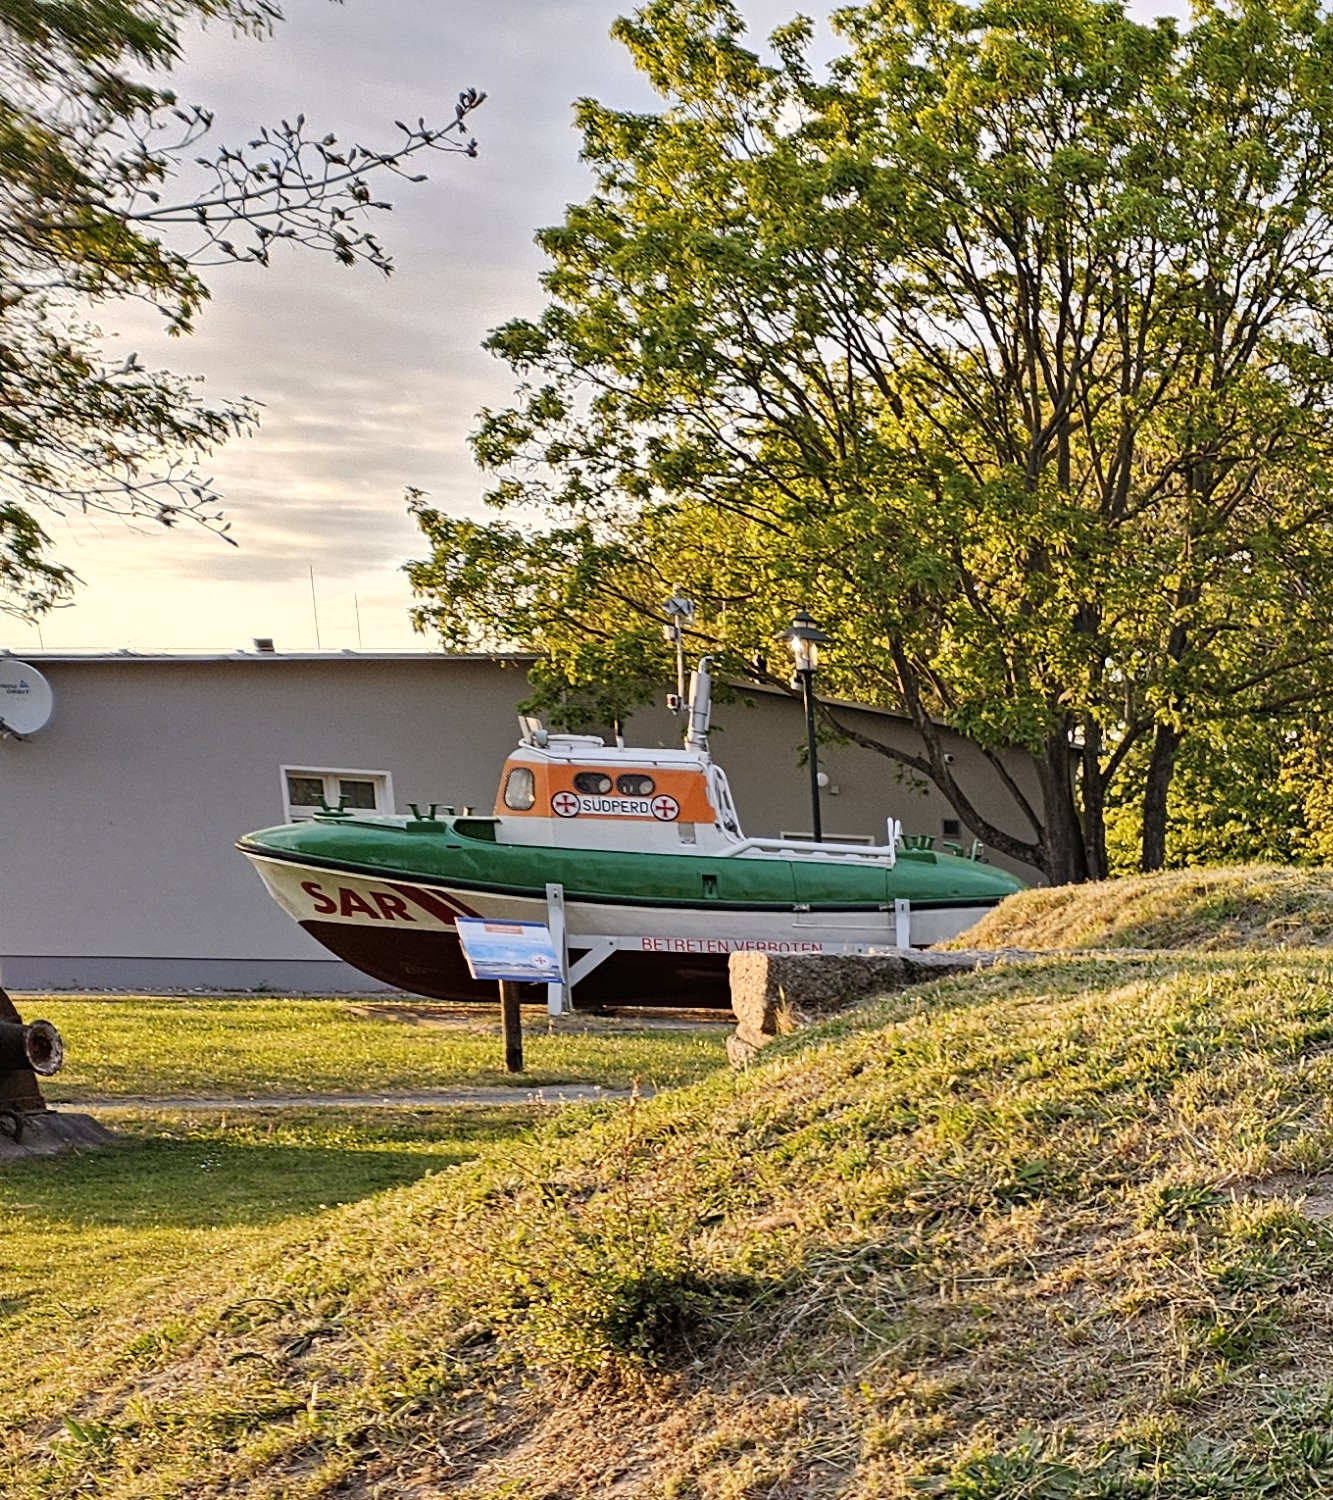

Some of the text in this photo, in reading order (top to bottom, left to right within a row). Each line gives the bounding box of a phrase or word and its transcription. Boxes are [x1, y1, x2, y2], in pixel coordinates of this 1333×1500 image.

[582, 797, 649, 814] SÜDPERD
[300, 881, 418, 922] SAR
[641, 937, 730, 953] BETRETEN
